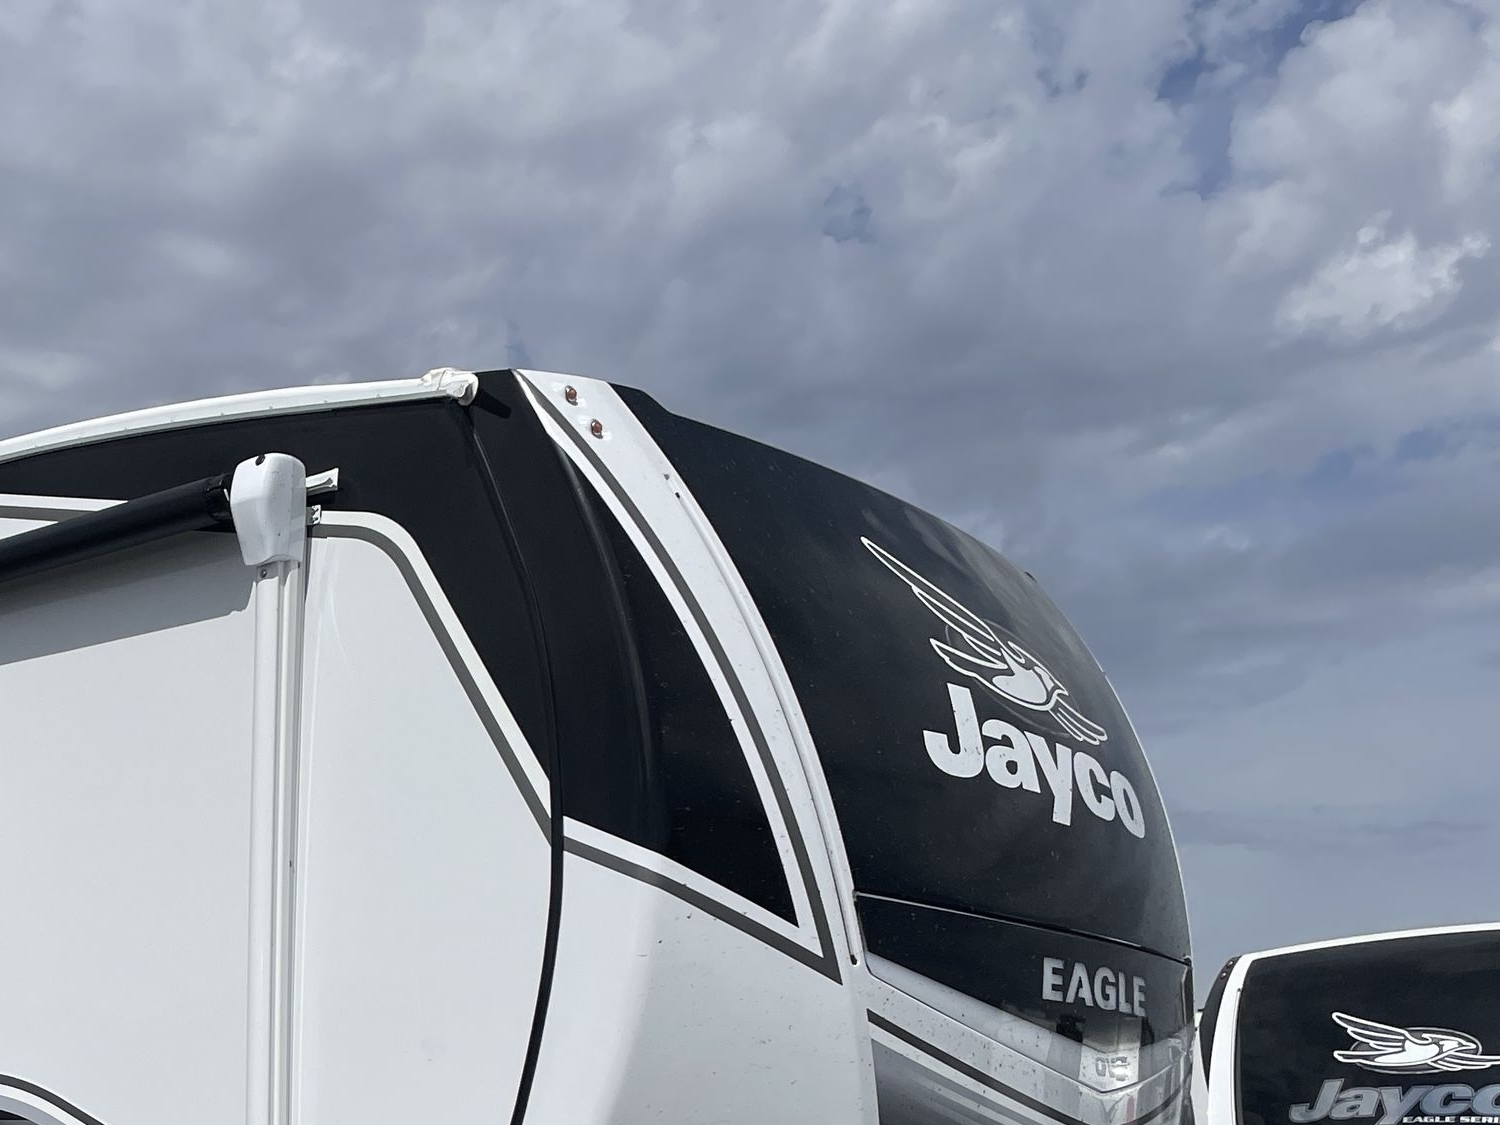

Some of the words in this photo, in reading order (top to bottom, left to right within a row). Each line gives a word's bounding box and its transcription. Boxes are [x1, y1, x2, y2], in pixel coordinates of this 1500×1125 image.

[923, 683, 1145, 839] Jayco
[1042, 957, 1146, 1017] EAGLE
[1402, 1116, 1457, 1124] EAGLE
[1459, 1116, 1500, 1124] SERI
